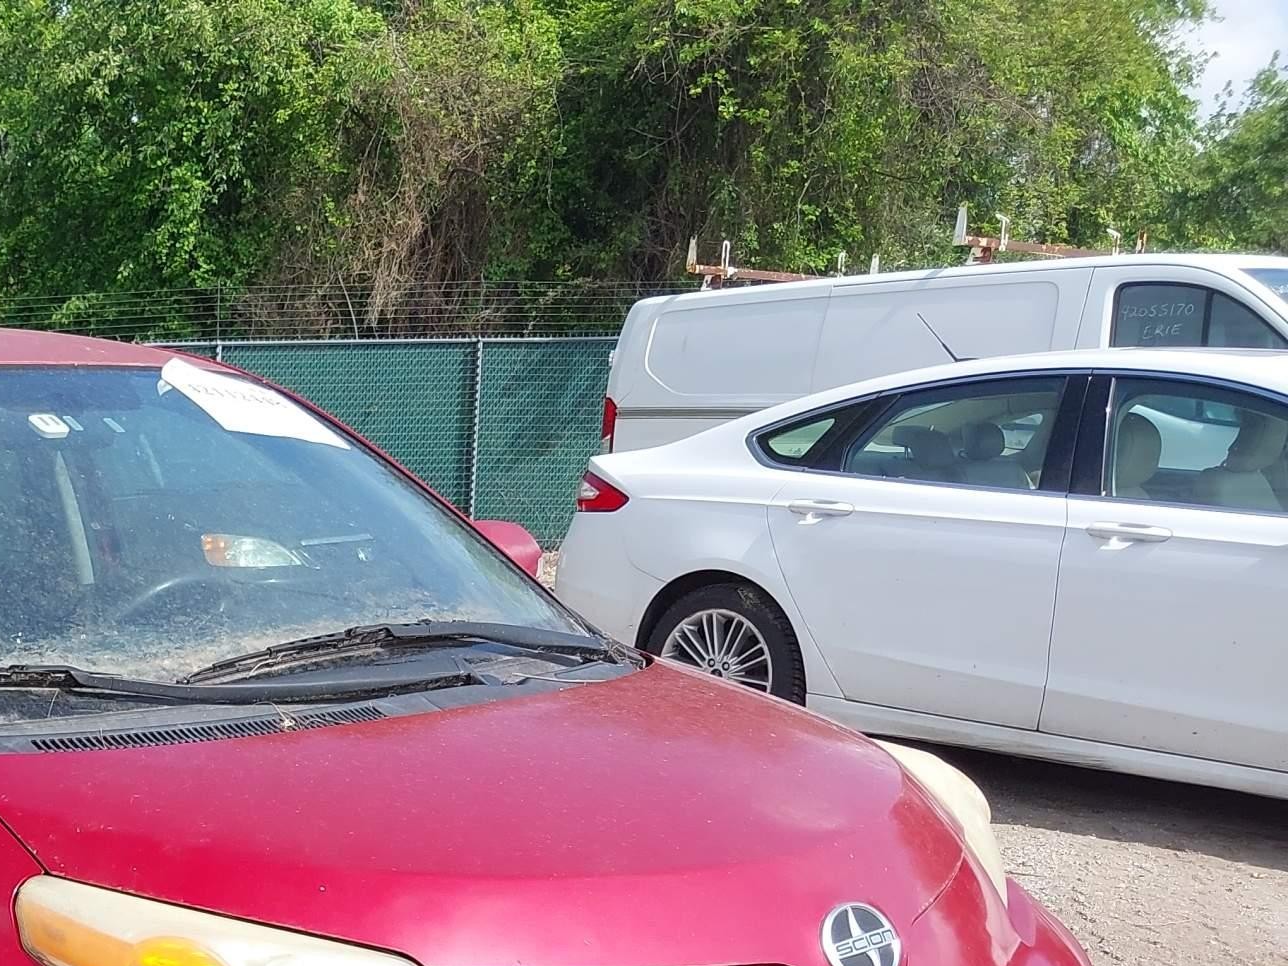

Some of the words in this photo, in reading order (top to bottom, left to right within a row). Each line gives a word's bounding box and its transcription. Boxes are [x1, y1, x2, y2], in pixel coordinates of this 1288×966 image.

[1120, 303, 1196, 320] 42055170
[1142, 323, 1183, 340] ERIE
[835, 928, 896, 957] SCION
